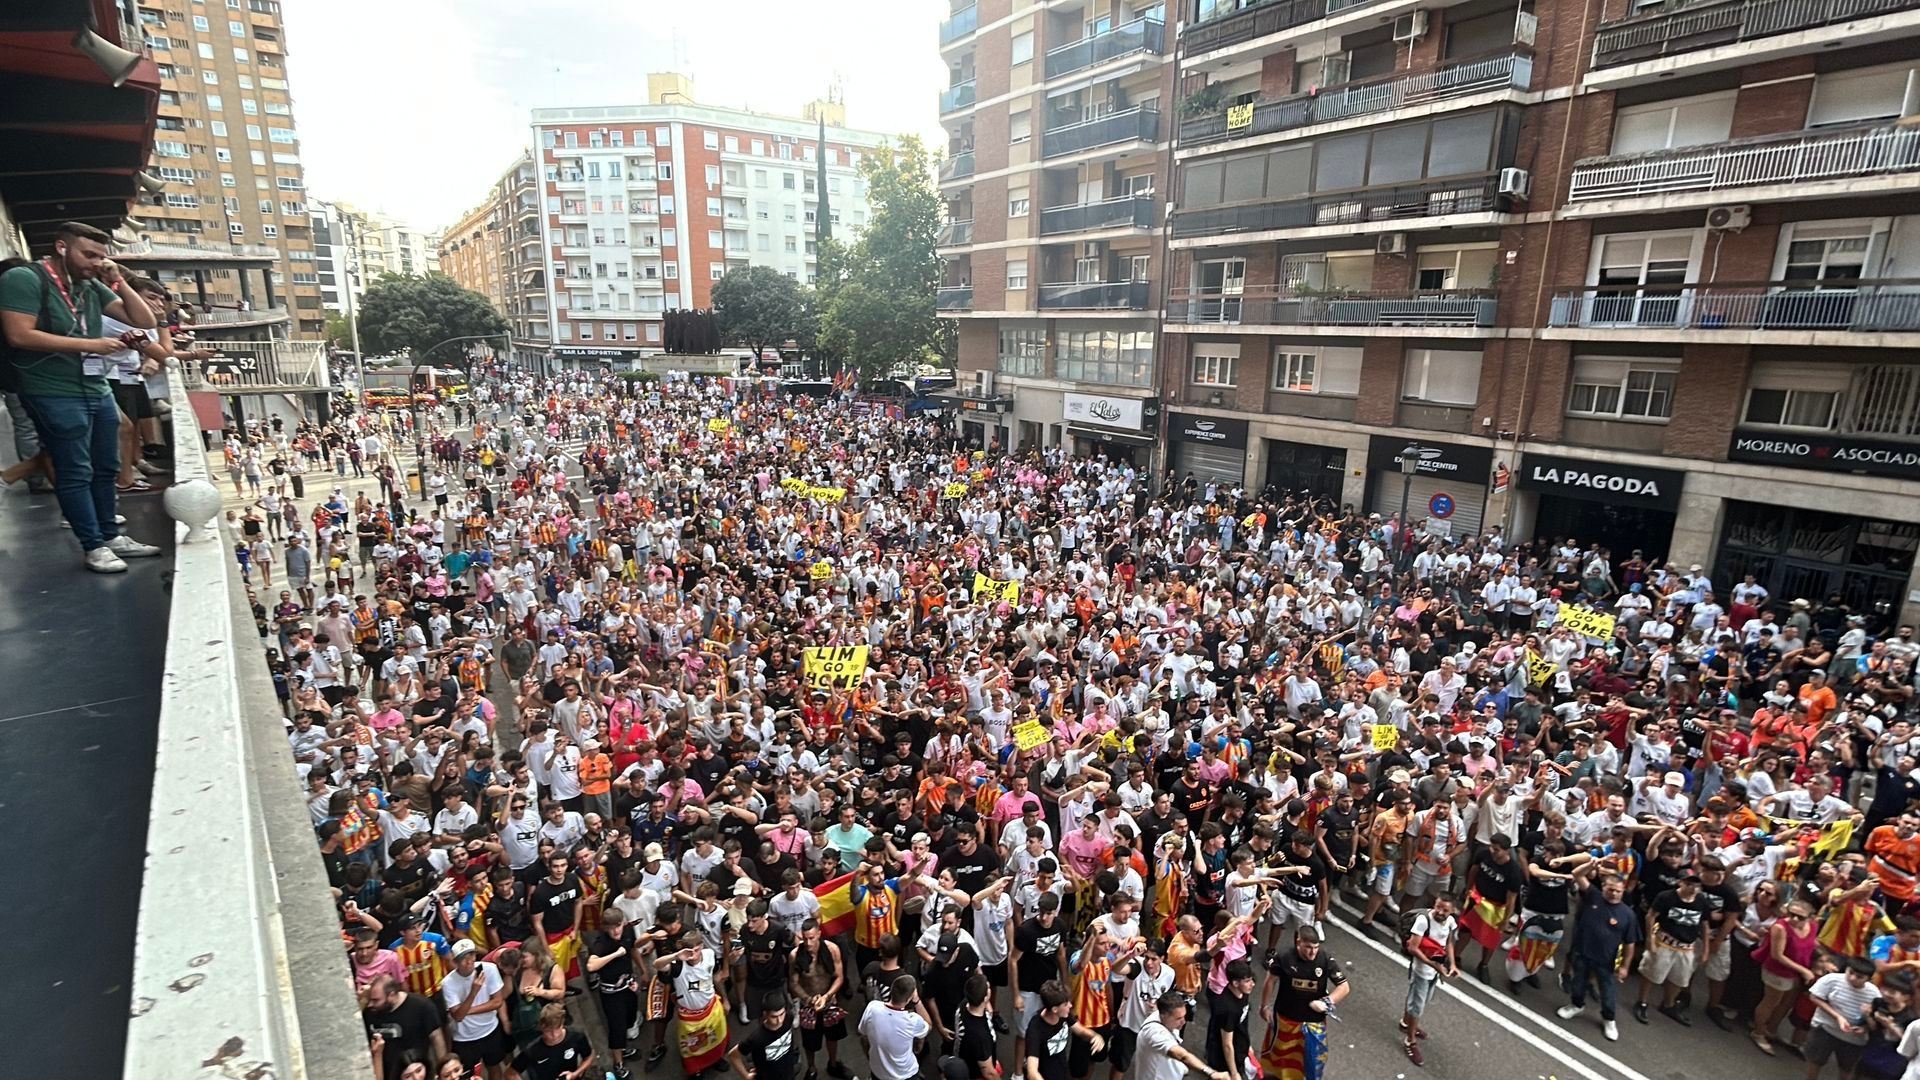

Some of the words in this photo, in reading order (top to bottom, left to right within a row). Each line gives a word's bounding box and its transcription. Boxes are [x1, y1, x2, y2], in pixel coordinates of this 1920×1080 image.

[240, 357, 256, 370] 52
[1736, 439, 1811, 456] MORENO
[1432, 461, 1458, 471] CENTER
[1533, 466, 1559, 483] LA
[1563, 470, 1660, 496] PAGODA
[1574, 613, 1594, 622] GO
[816, 647, 856, 661] LIM
[824, 662, 844, 672] GO
[1377, 726, 1393, 735] LIM
